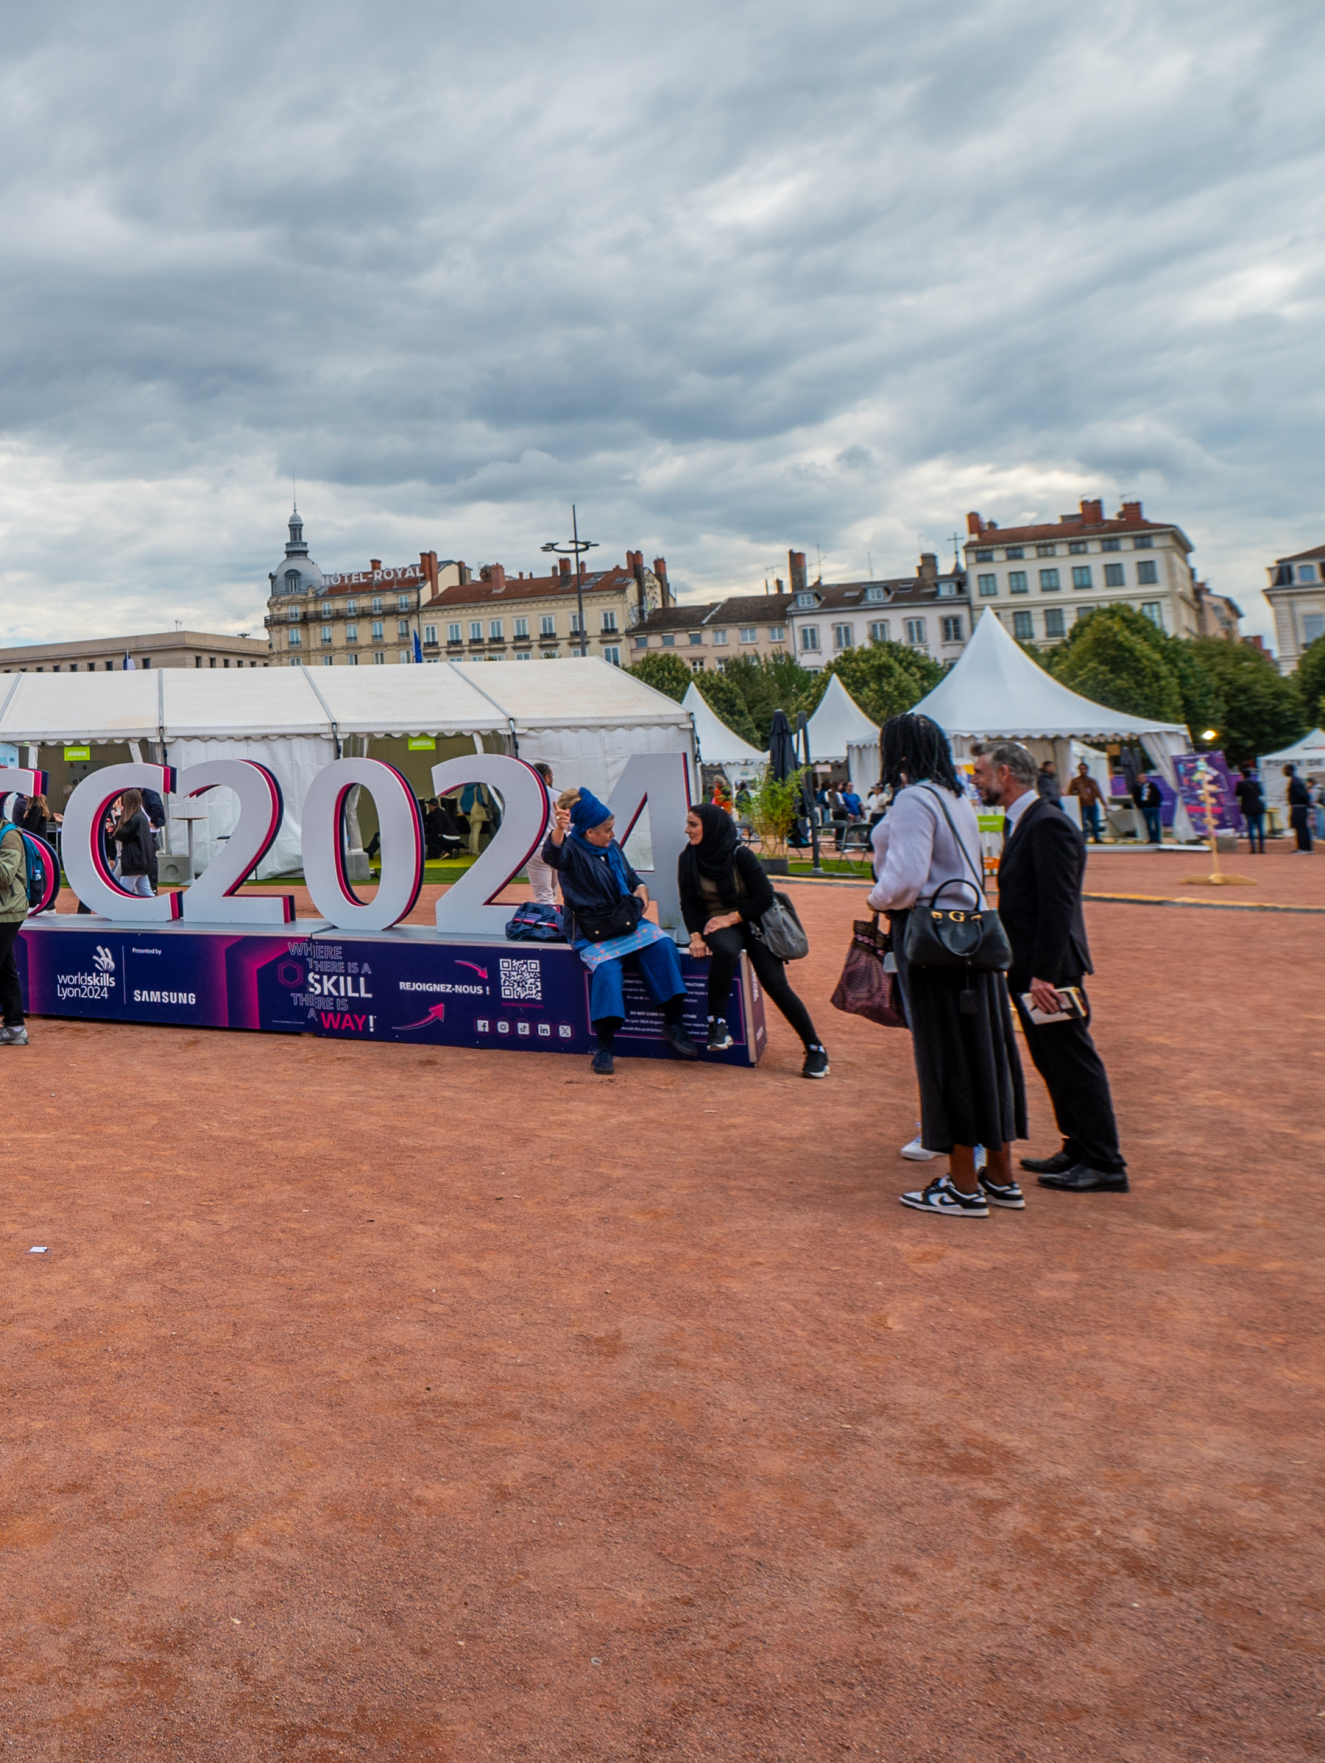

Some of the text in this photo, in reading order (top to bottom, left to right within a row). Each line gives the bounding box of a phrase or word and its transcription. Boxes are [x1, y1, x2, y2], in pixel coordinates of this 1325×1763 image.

[132, 947, 162, 955] Presented by
[287, 942, 343, 960] WHERE
[306, 957, 372, 975] THERE IS A
[57, 972, 116, 987] worldskills
[307, 972, 373, 998] SKILL
[57, 984, 109, 1000] Lyon2024
[399, 981, 490, 995] REJOIGNEZ-NOUS !
[133, 989, 196, 1005] SAMSUNG
[290, 992, 349, 1012] THERE IS
[307, 1007, 318, 1021] A
[320, 1012, 374, 1032] WAY!
